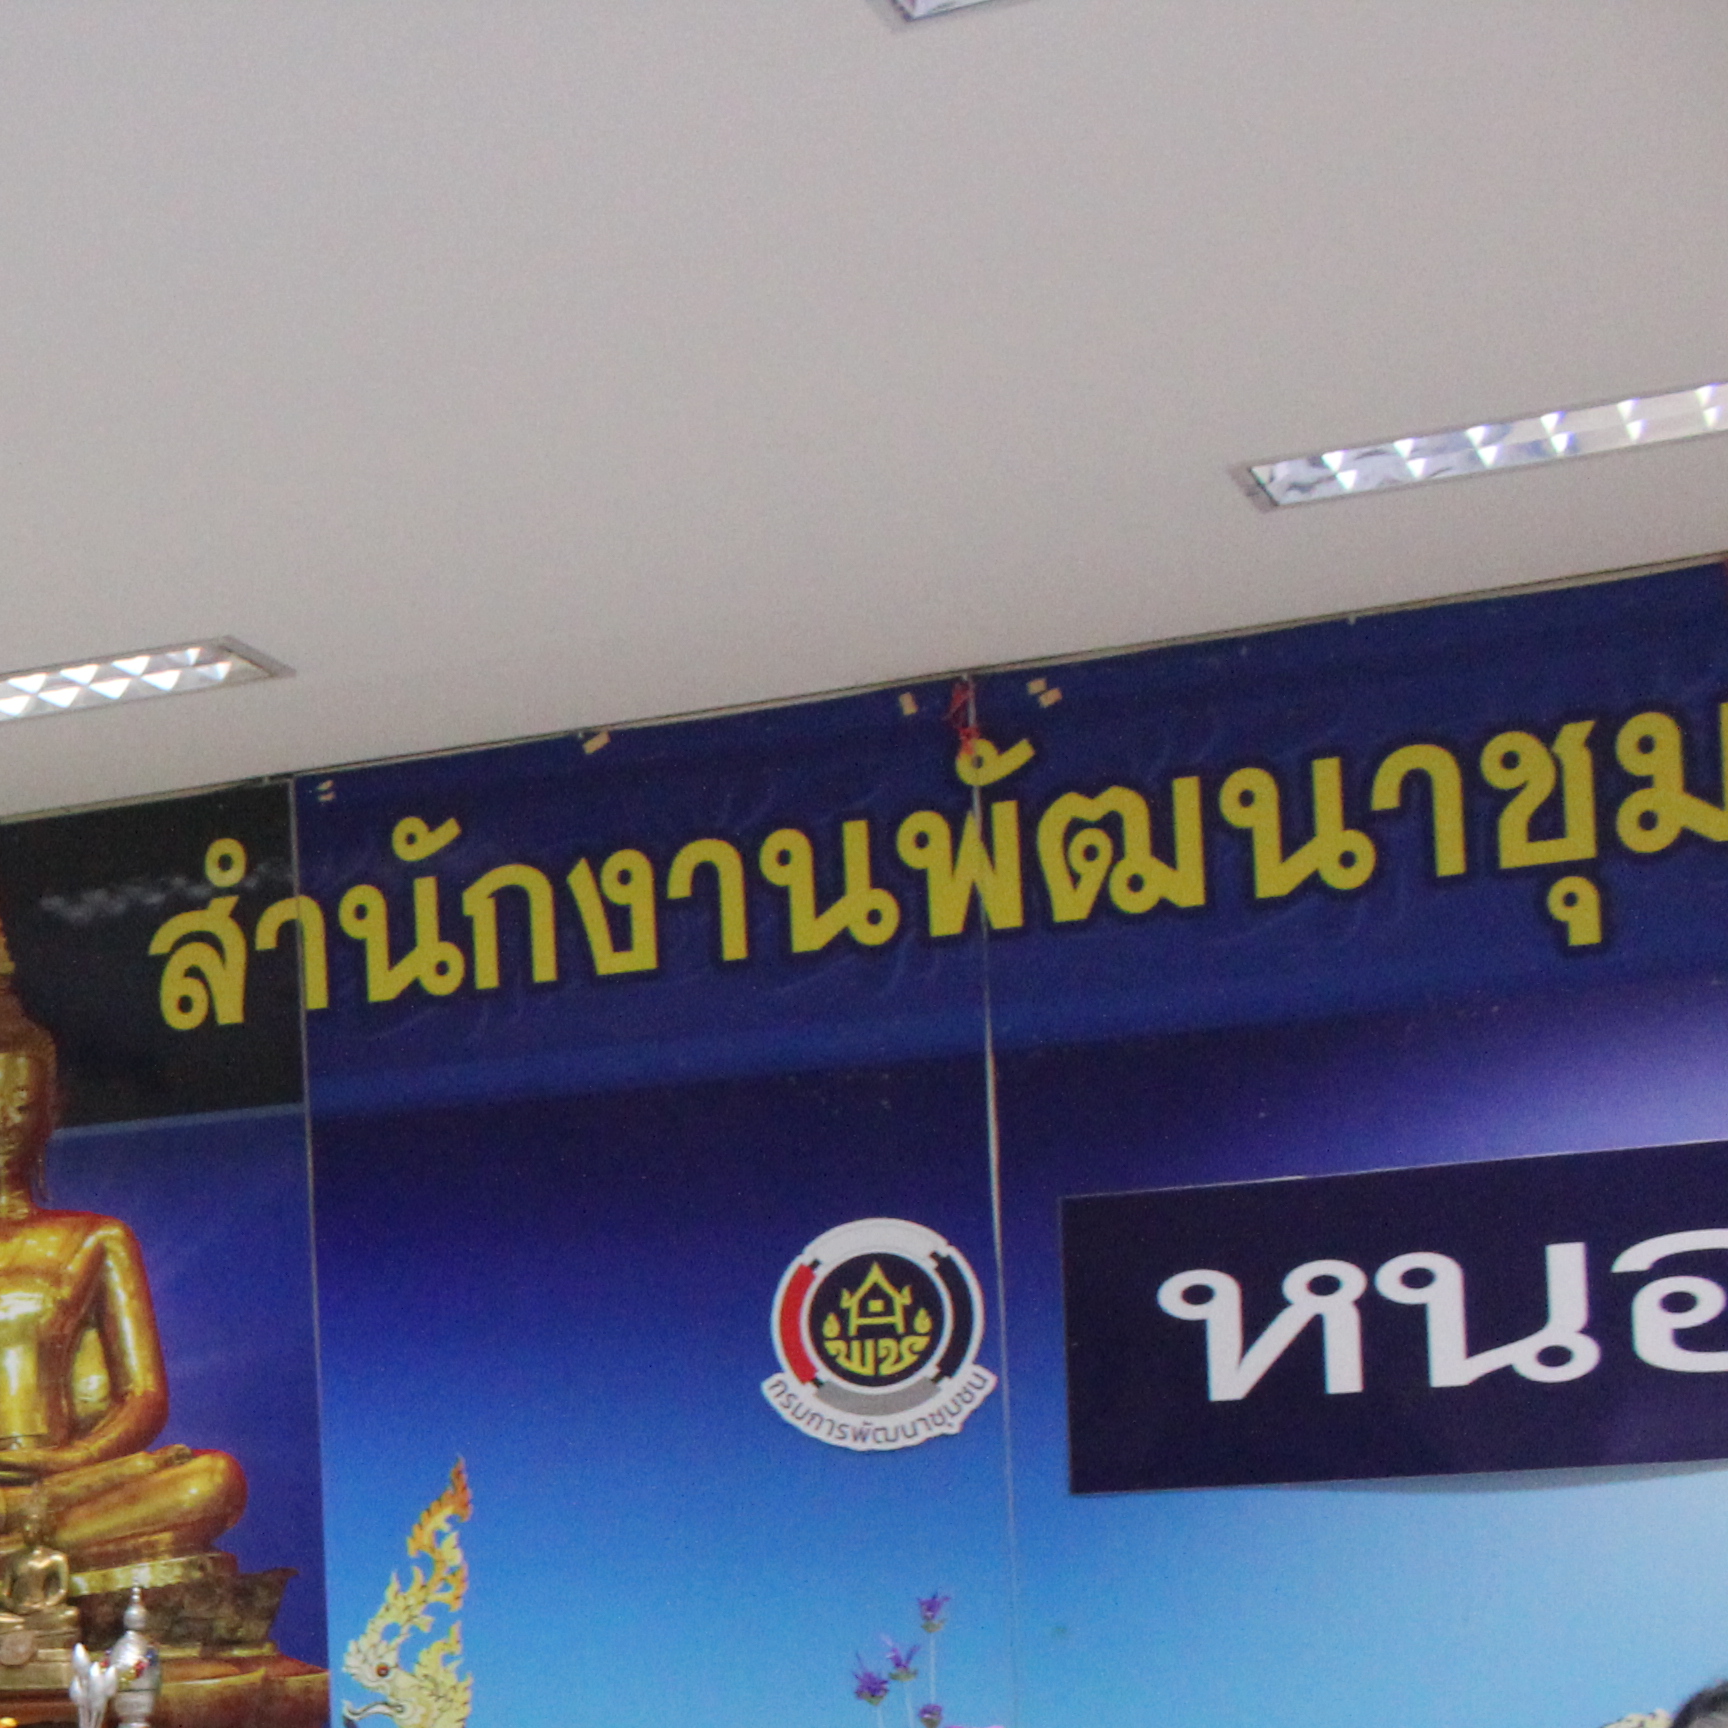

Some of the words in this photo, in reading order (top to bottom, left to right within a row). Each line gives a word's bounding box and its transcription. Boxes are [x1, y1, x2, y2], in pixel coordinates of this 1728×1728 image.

[148, 702, 1728, 1031] สำนักงานพัฒนาชุม
[767, 1371, 989, 1444] กรมการพัฒนาชุมชน
